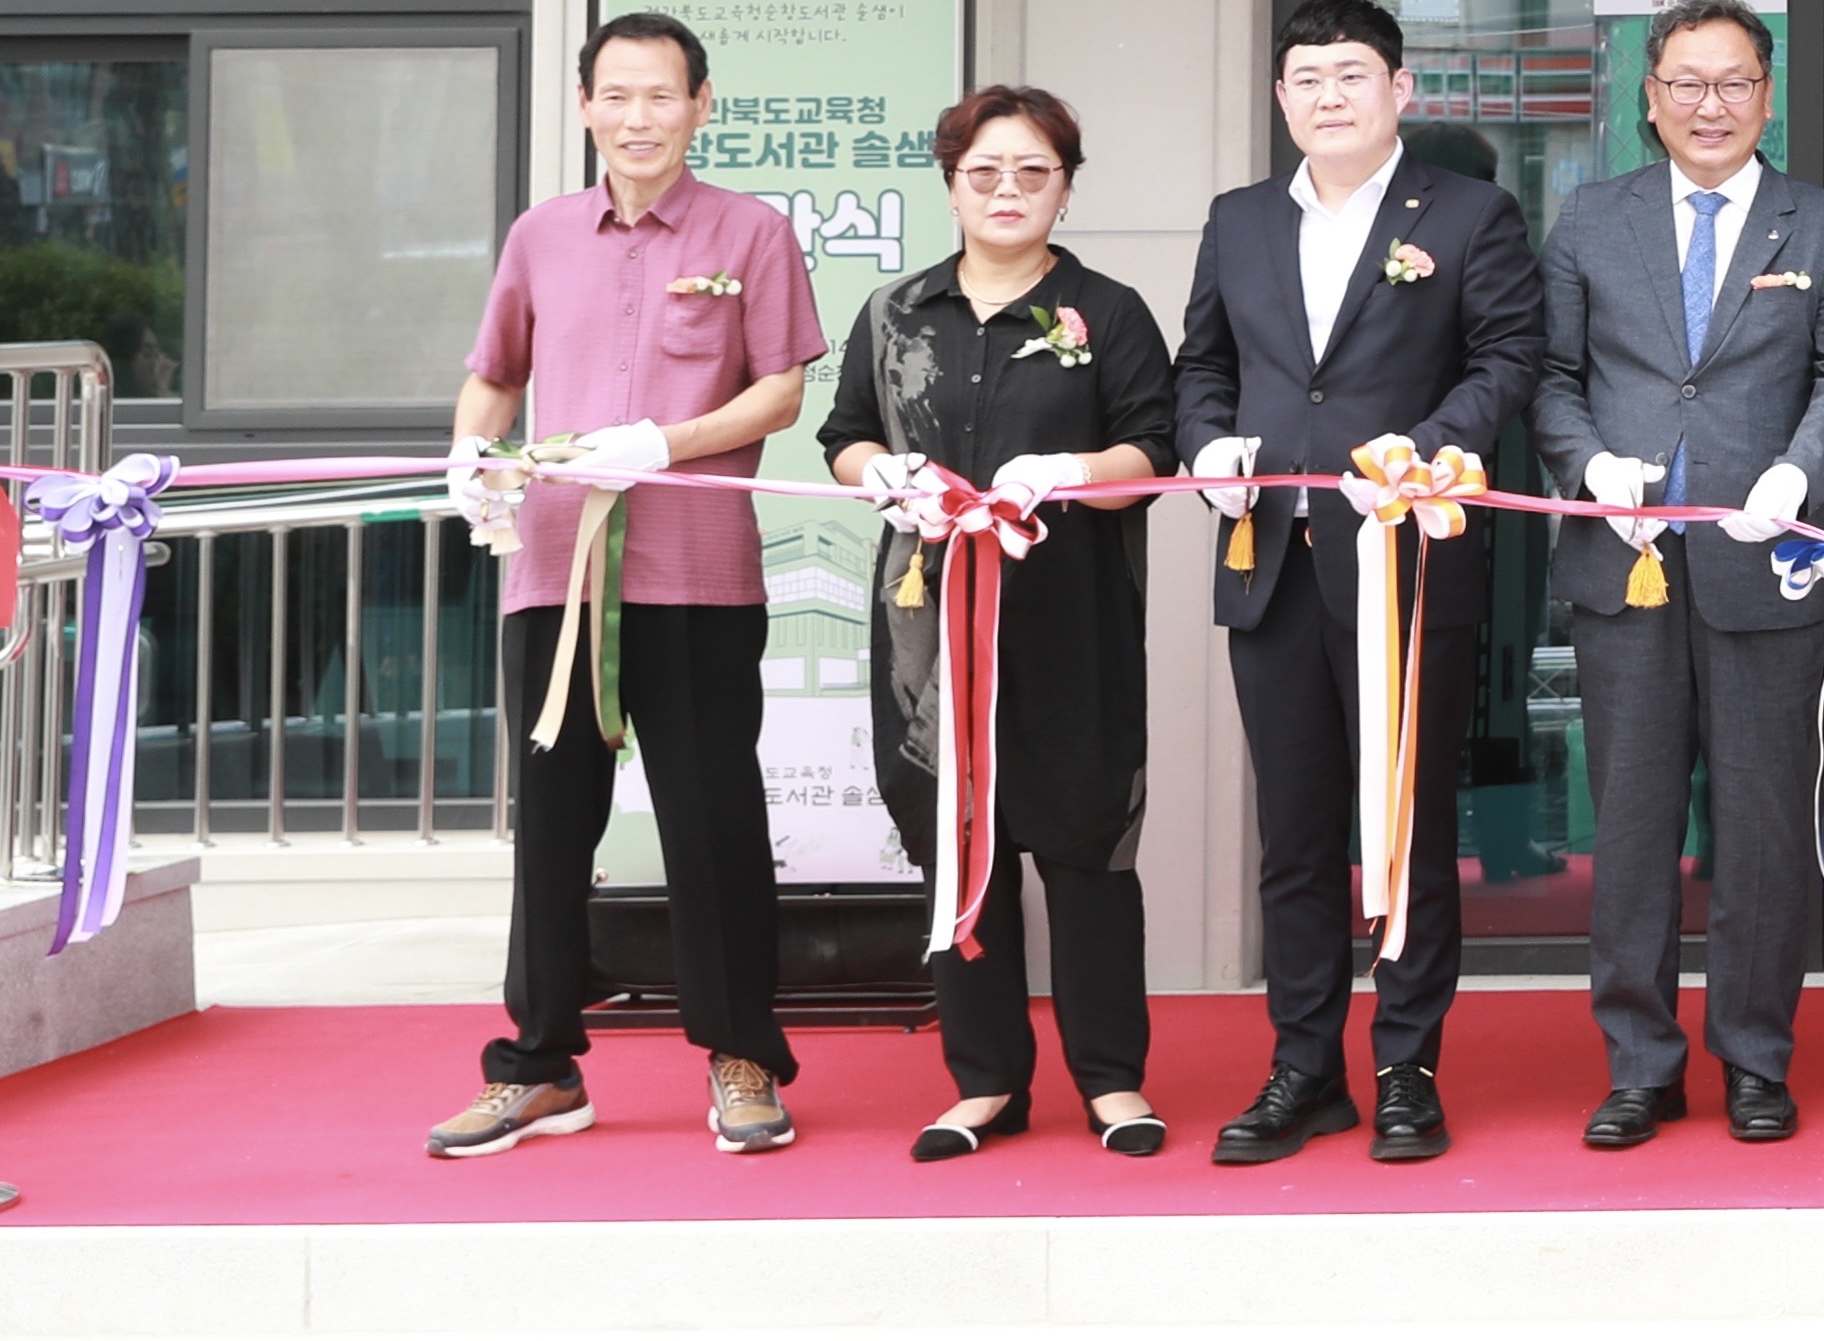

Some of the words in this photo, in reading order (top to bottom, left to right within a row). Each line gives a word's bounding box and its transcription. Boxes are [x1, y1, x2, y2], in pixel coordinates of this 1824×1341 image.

[756, 28, 848, 46] 시작합니다.
[707, 96, 886, 125] 라북도교육청
[685, 130, 840, 169] 창도서관
[852, 130, 936, 169] 솔샘
[766, 765, 832, 779] 도교육청
[765, 785, 834, 806] 도서관
